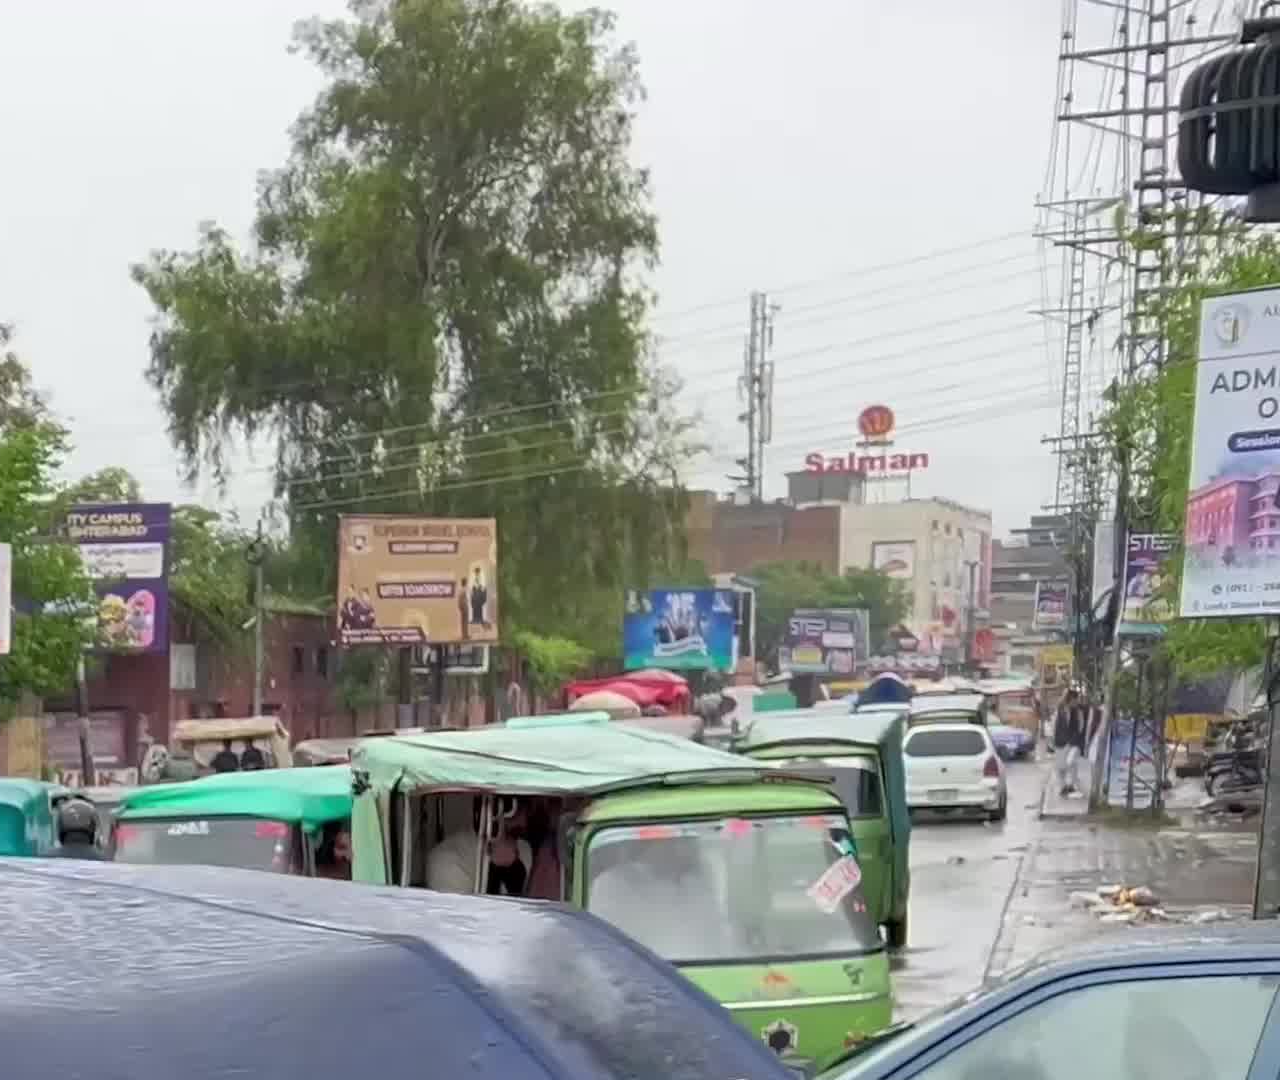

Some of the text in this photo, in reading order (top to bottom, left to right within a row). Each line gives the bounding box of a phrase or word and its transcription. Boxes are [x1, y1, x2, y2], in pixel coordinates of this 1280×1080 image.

[1209, 364, 1280, 395] ADM
[804, 451, 930, 475] Salman
[89, 511, 144, 525] CAMPUS
